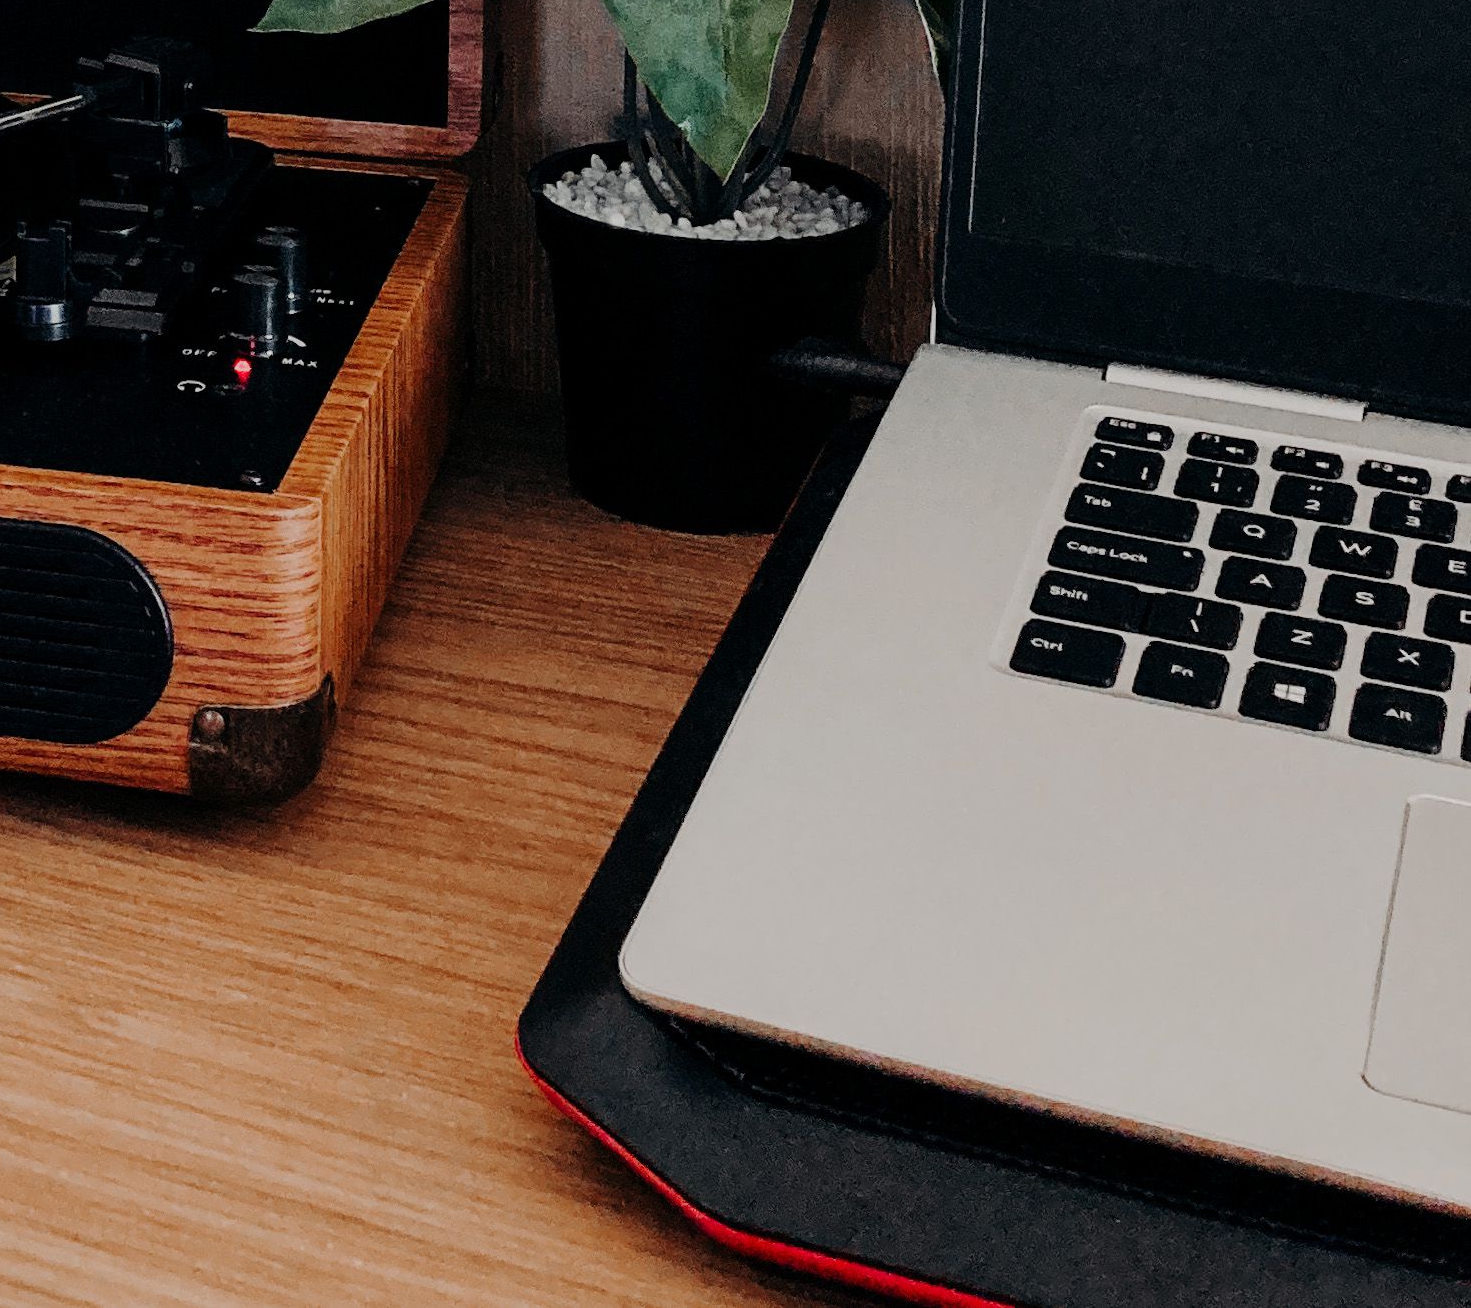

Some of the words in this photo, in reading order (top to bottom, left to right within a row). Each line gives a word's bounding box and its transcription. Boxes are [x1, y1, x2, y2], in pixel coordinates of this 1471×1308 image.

[281, 357, 318, 368] MAX
[1108, 417, 1138, 430] Esc
[1284, 446, 1306, 458] F2
[1370, 461, 1394, 473] F3
[1210, 482, 1220, 493] 1
[1084, 494, 1112, 508] Tab
[1304, 498, 1321, 511] 2
[1405, 515, 1421, 528] 3
[1242, 524, 1266, 539] Q
[1066, 540, 1107, 556] Caps
[1109, 548, 1148, 564] Lock
[1339, 539, 1372, 557] W
[1447, 559, 1467, 575] E
[1249, 573, 1273, 589] A
[1049, 585, 1089, 602] Shift
[1355, 591, 1375, 606] S
[1290, 628, 1314, 646] Z
[1029, 637, 1064, 652] Ctrl
[1396, 648, 1420, 666] X
[1170, 664, 1194, 678] Fn
[1383, 708, 1412, 722] Alt
